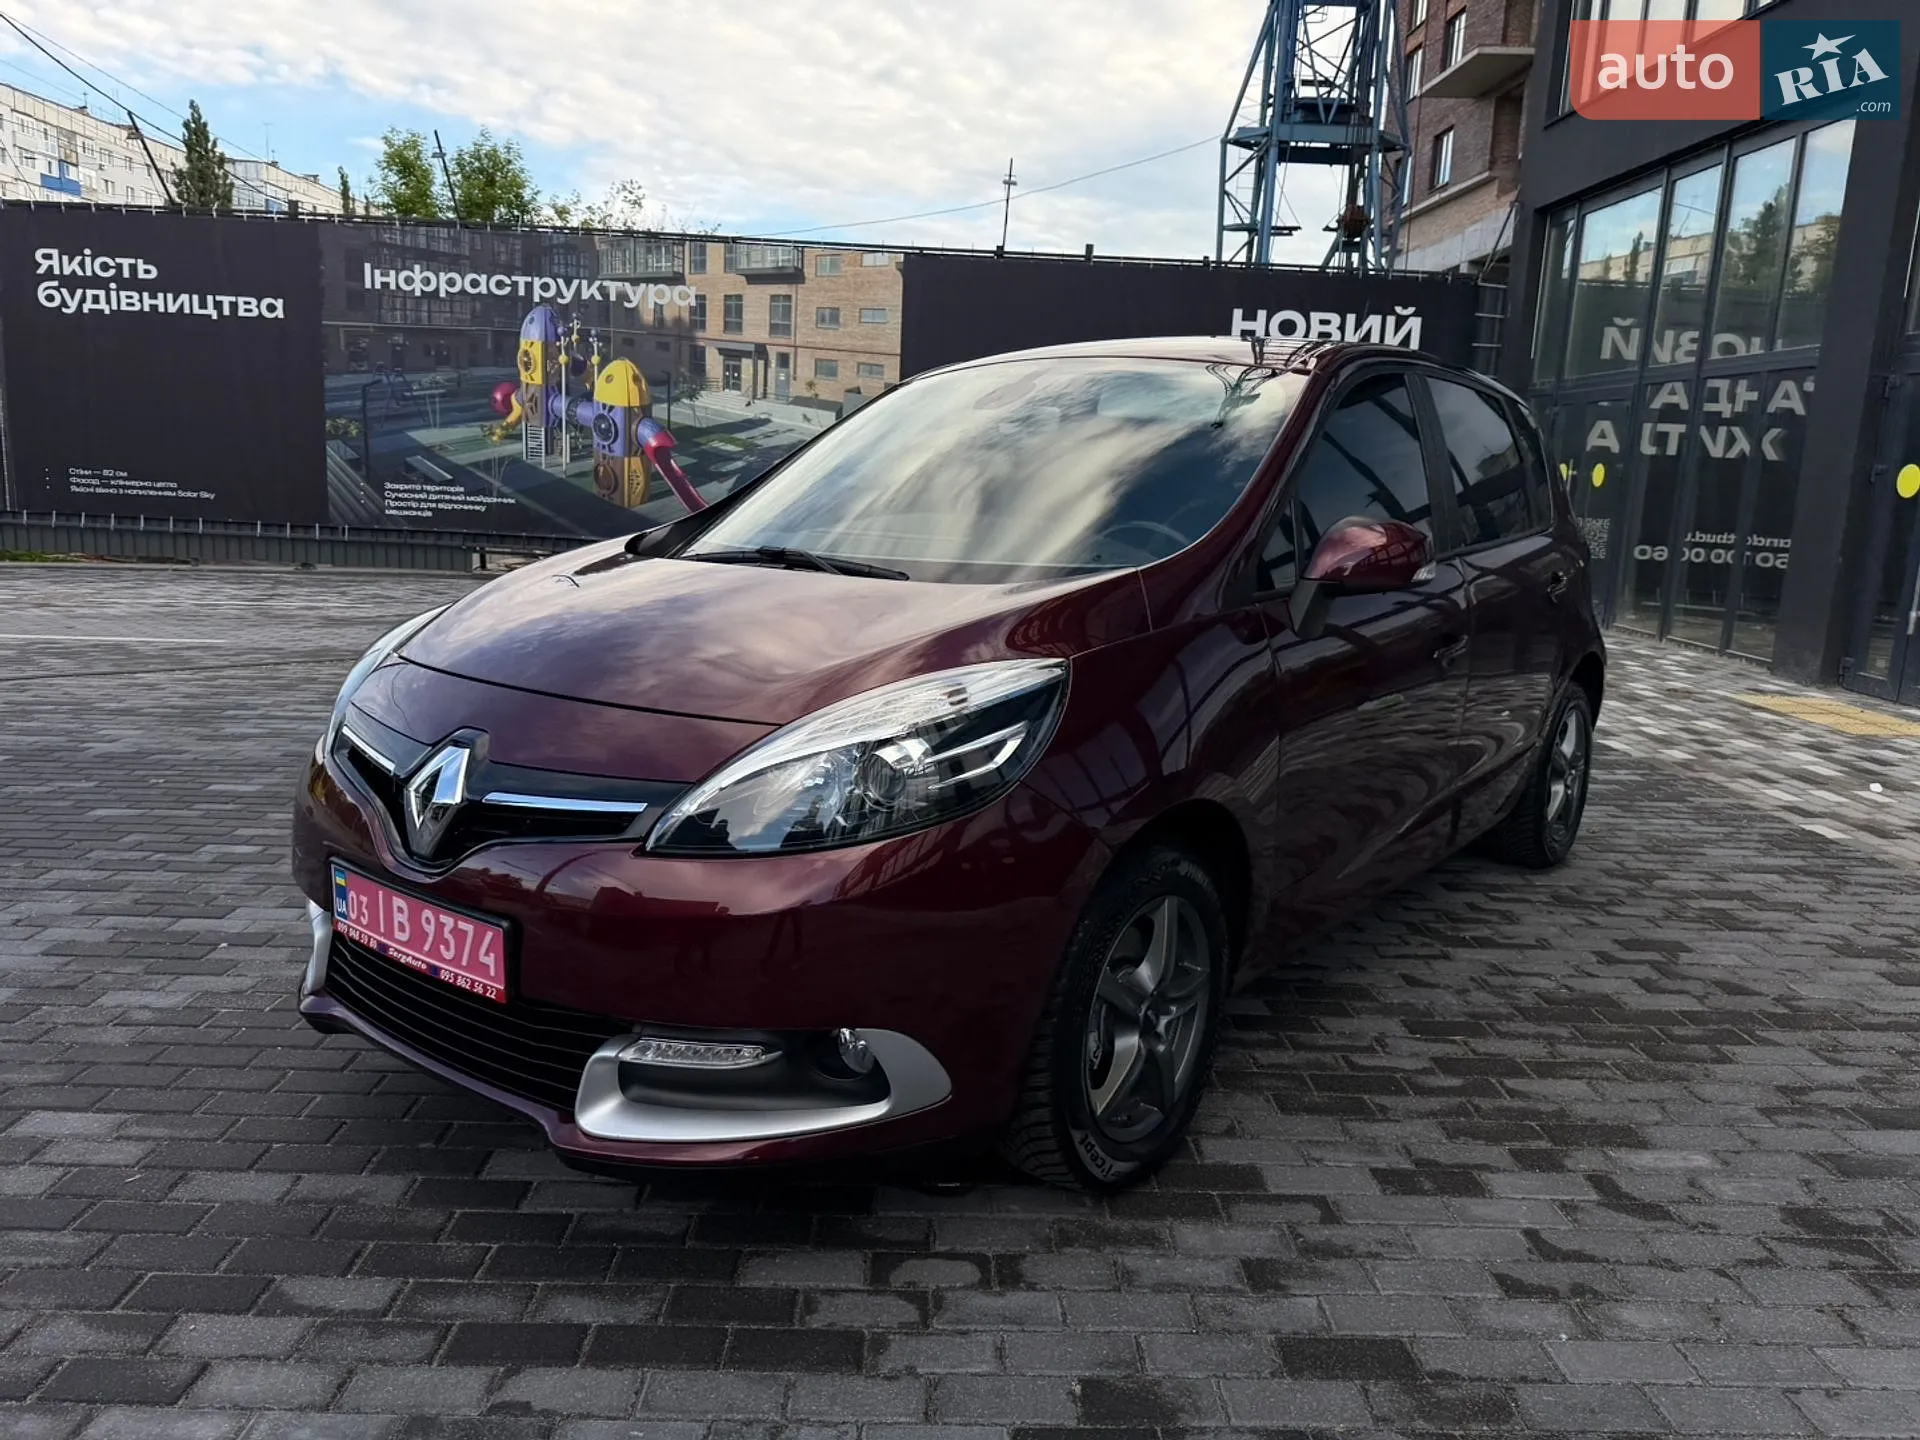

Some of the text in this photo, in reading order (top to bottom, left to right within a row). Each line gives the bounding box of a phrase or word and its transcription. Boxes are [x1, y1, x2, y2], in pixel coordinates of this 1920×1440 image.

[34, 248, 159, 280] Якість
[37, 280, 285, 320] будівництва
[364, 262, 697, 308] Інфраструктура
[1231, 306, 1423, 350] НОВИЙ
[177, 489, 198, 498] Solar
[199, 490, 216, 500] Sky
[336, 897, 347, 914] UA
[348, 890, 369, 926] 03
[421, 909, 496, 977] 9374
[485, 986, 498, 999] 22
